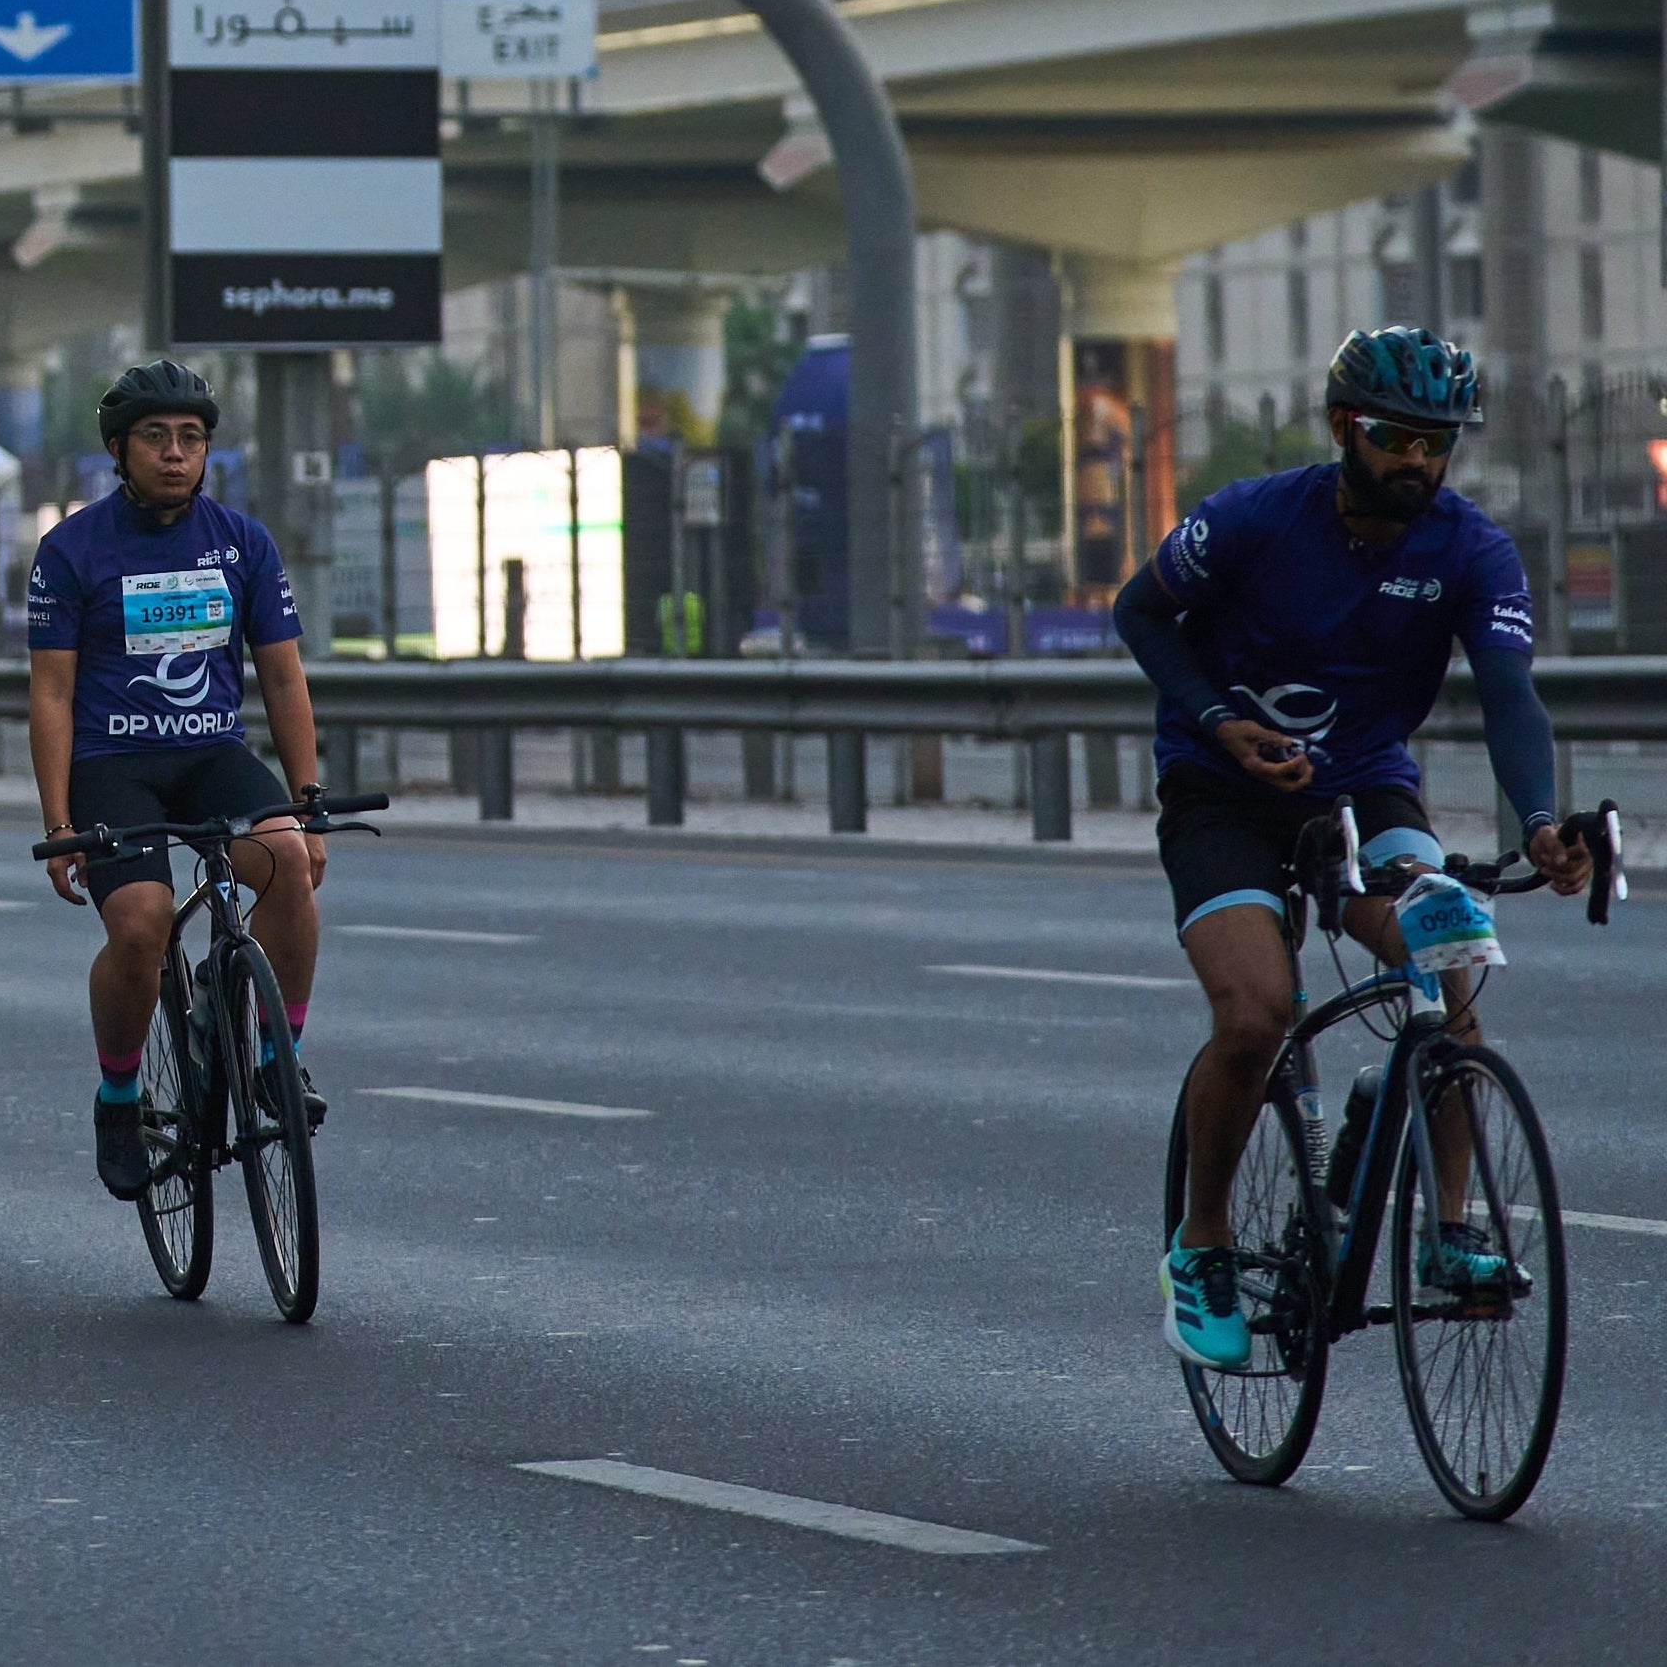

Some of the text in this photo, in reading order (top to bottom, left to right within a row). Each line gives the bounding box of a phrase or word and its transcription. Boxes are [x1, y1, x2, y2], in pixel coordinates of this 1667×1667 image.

[494, 35, 560, 63] EXIT
[221, 279, 394, 315] sephora.me
[136, 581, 161, 590] RIDE
[1378, 581, 1418, 598] RIDE
[141, 604, 197, 623] 19391
[108, 712, 235, 735] DP WORLD
